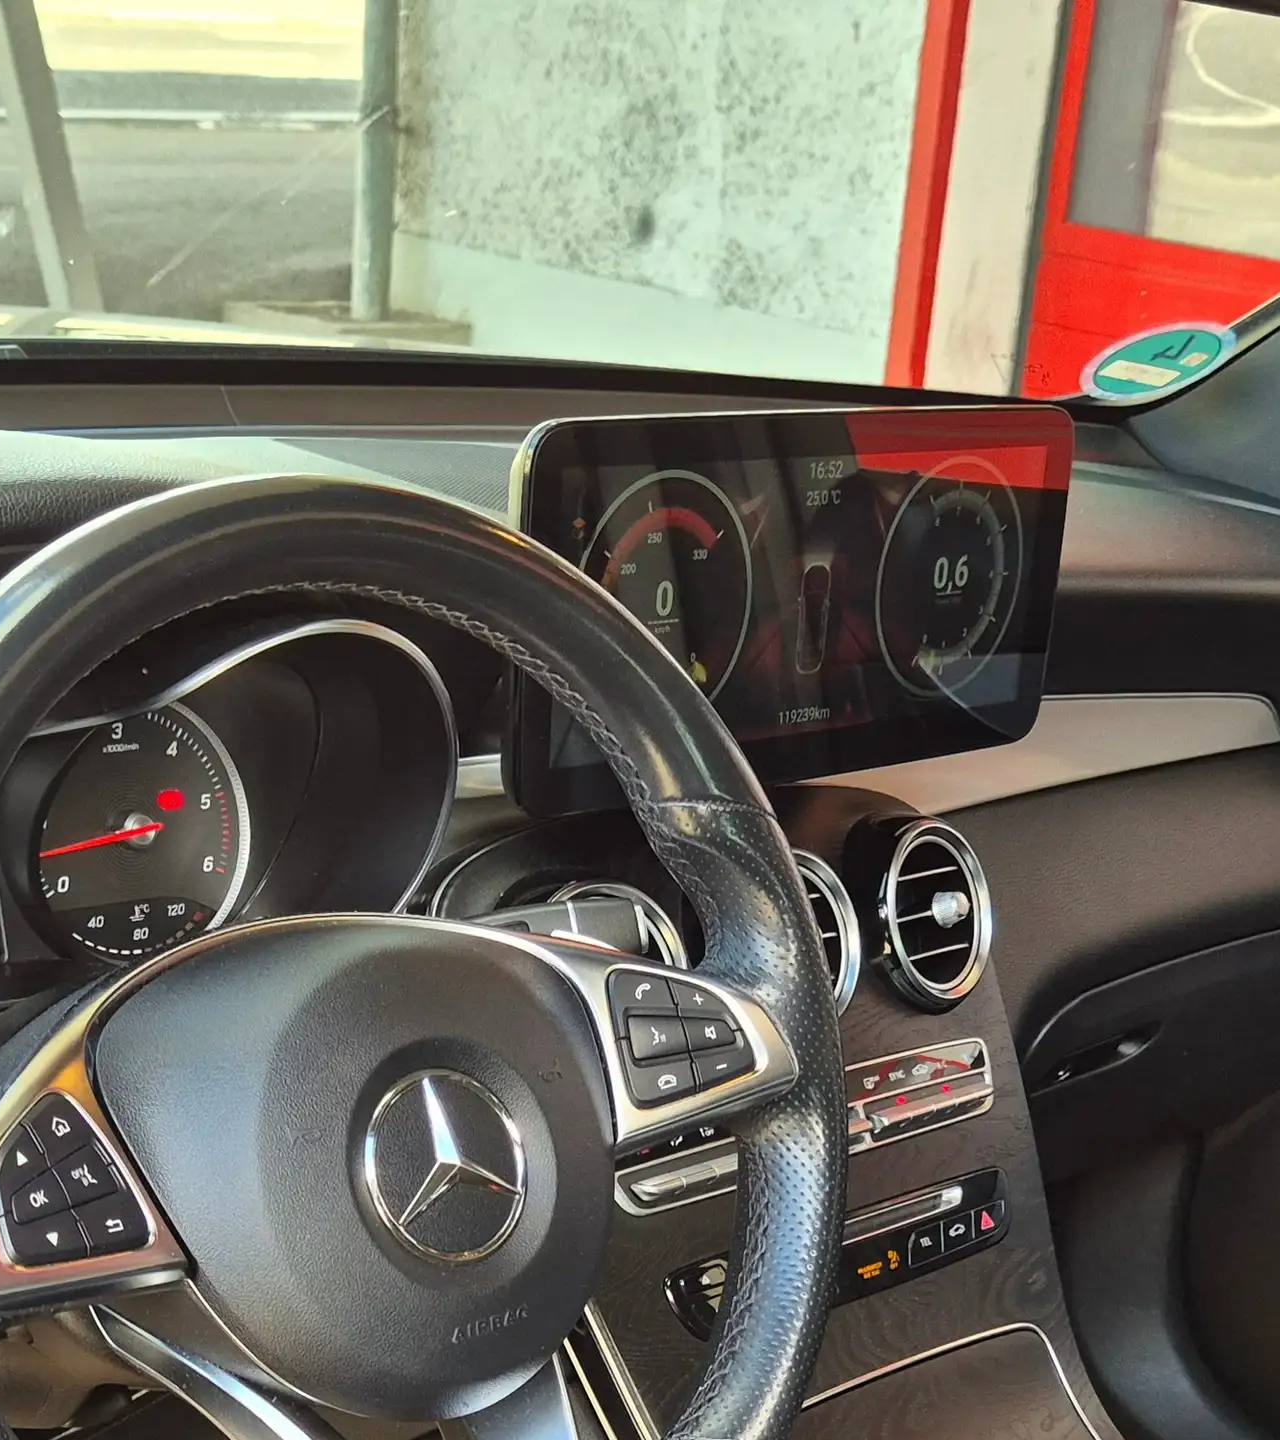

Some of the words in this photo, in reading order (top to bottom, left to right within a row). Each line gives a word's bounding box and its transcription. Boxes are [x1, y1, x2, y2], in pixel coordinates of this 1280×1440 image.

[810, 460, 844, 479] 16:52
[647, 531, 663, 544] 250
[692, 548, 708, 561] 330
[621, 563, 637, 575] 200
[933, 554, 969, 593] 0,6
[655, 580, 674, 617] 0
[111, 721, 124, 740] 3
[165, 740, 178, 757] 4
[200, 793, 211, 810] 5
[202, 856, 214, 872] 6
[57, 876, 69, 894] 0
[166, 903, 186, 917] 120
[87, 915, 105, 929] 40
[132, 927, 150, 941] 80
[29, 1189, 50, 1208] OK
[451, 1303, 529, 1344] AIRBAG
